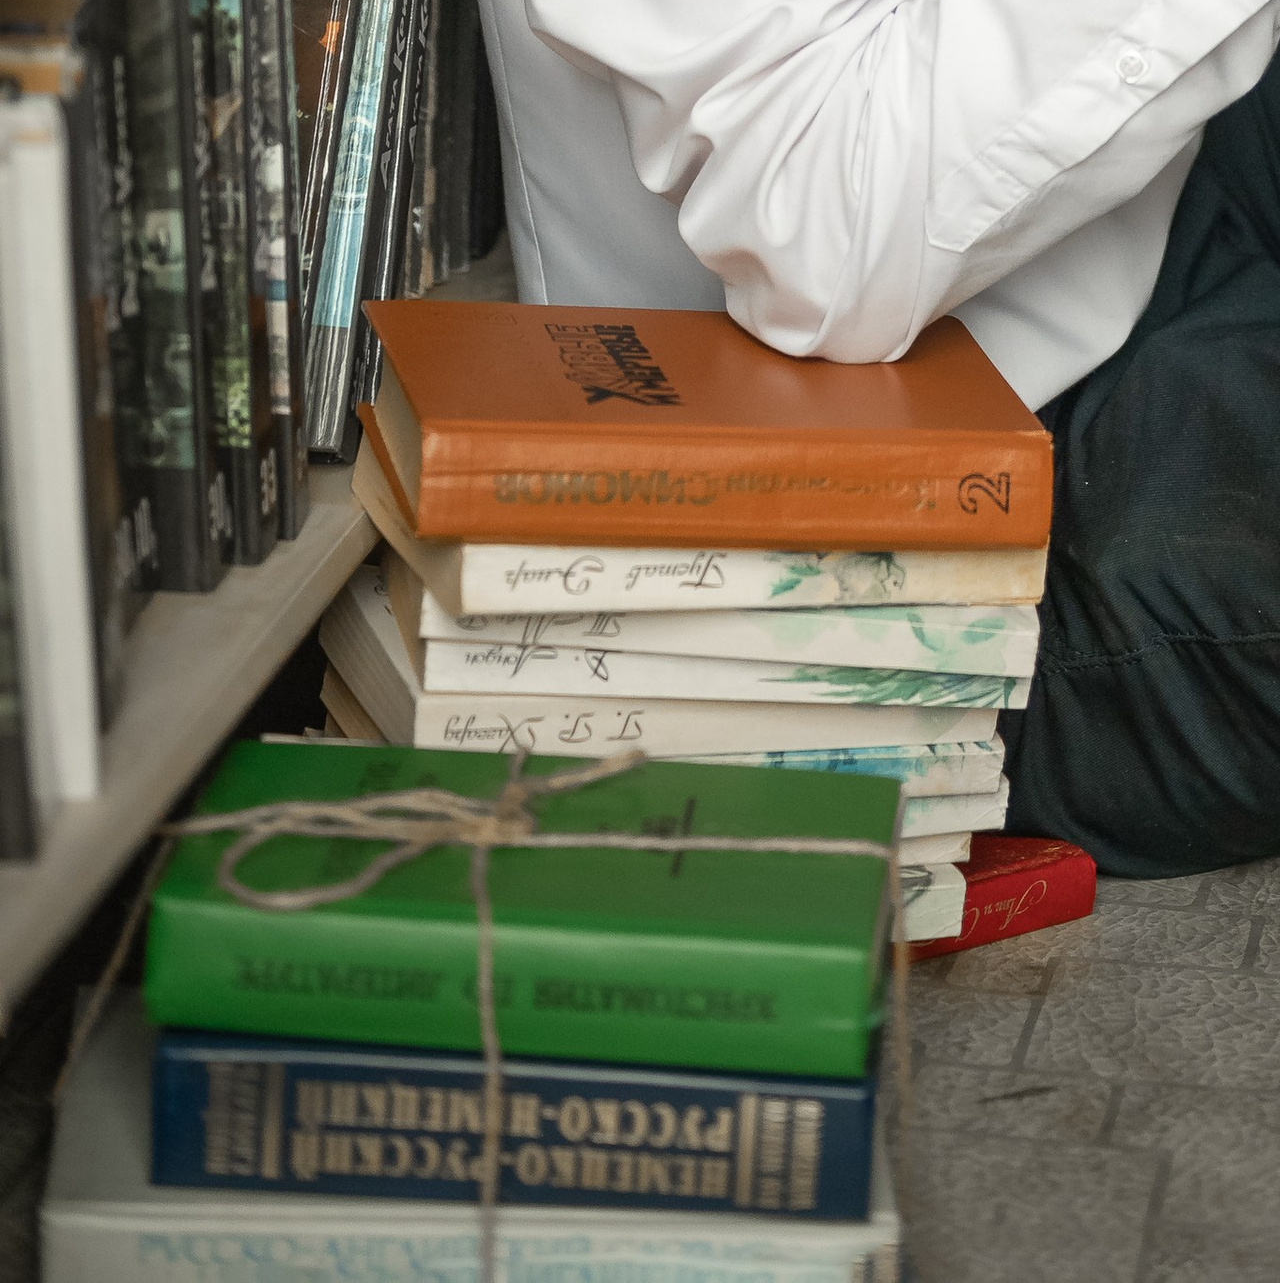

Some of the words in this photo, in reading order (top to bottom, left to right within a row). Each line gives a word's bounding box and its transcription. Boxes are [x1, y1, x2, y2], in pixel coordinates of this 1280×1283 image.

[492, 469, 720, 508] СИМОНОВ
[957, 470, 1012, 515] 2
[503, 555, 606, 596] Эмар
[624, 549, 728, 593] Густав
[463, 642, 560, 681] Лондон
[441, 713, 547, 753] Хаггард
[232, 958, 447, 1006] ЛИТЕРАТУРЕ
[533, 976, 778, 1024] ХРЕСТОМАТИЯ
[293, 1079, 734, 1150] РУССКО-НМЕЦКИЙ
